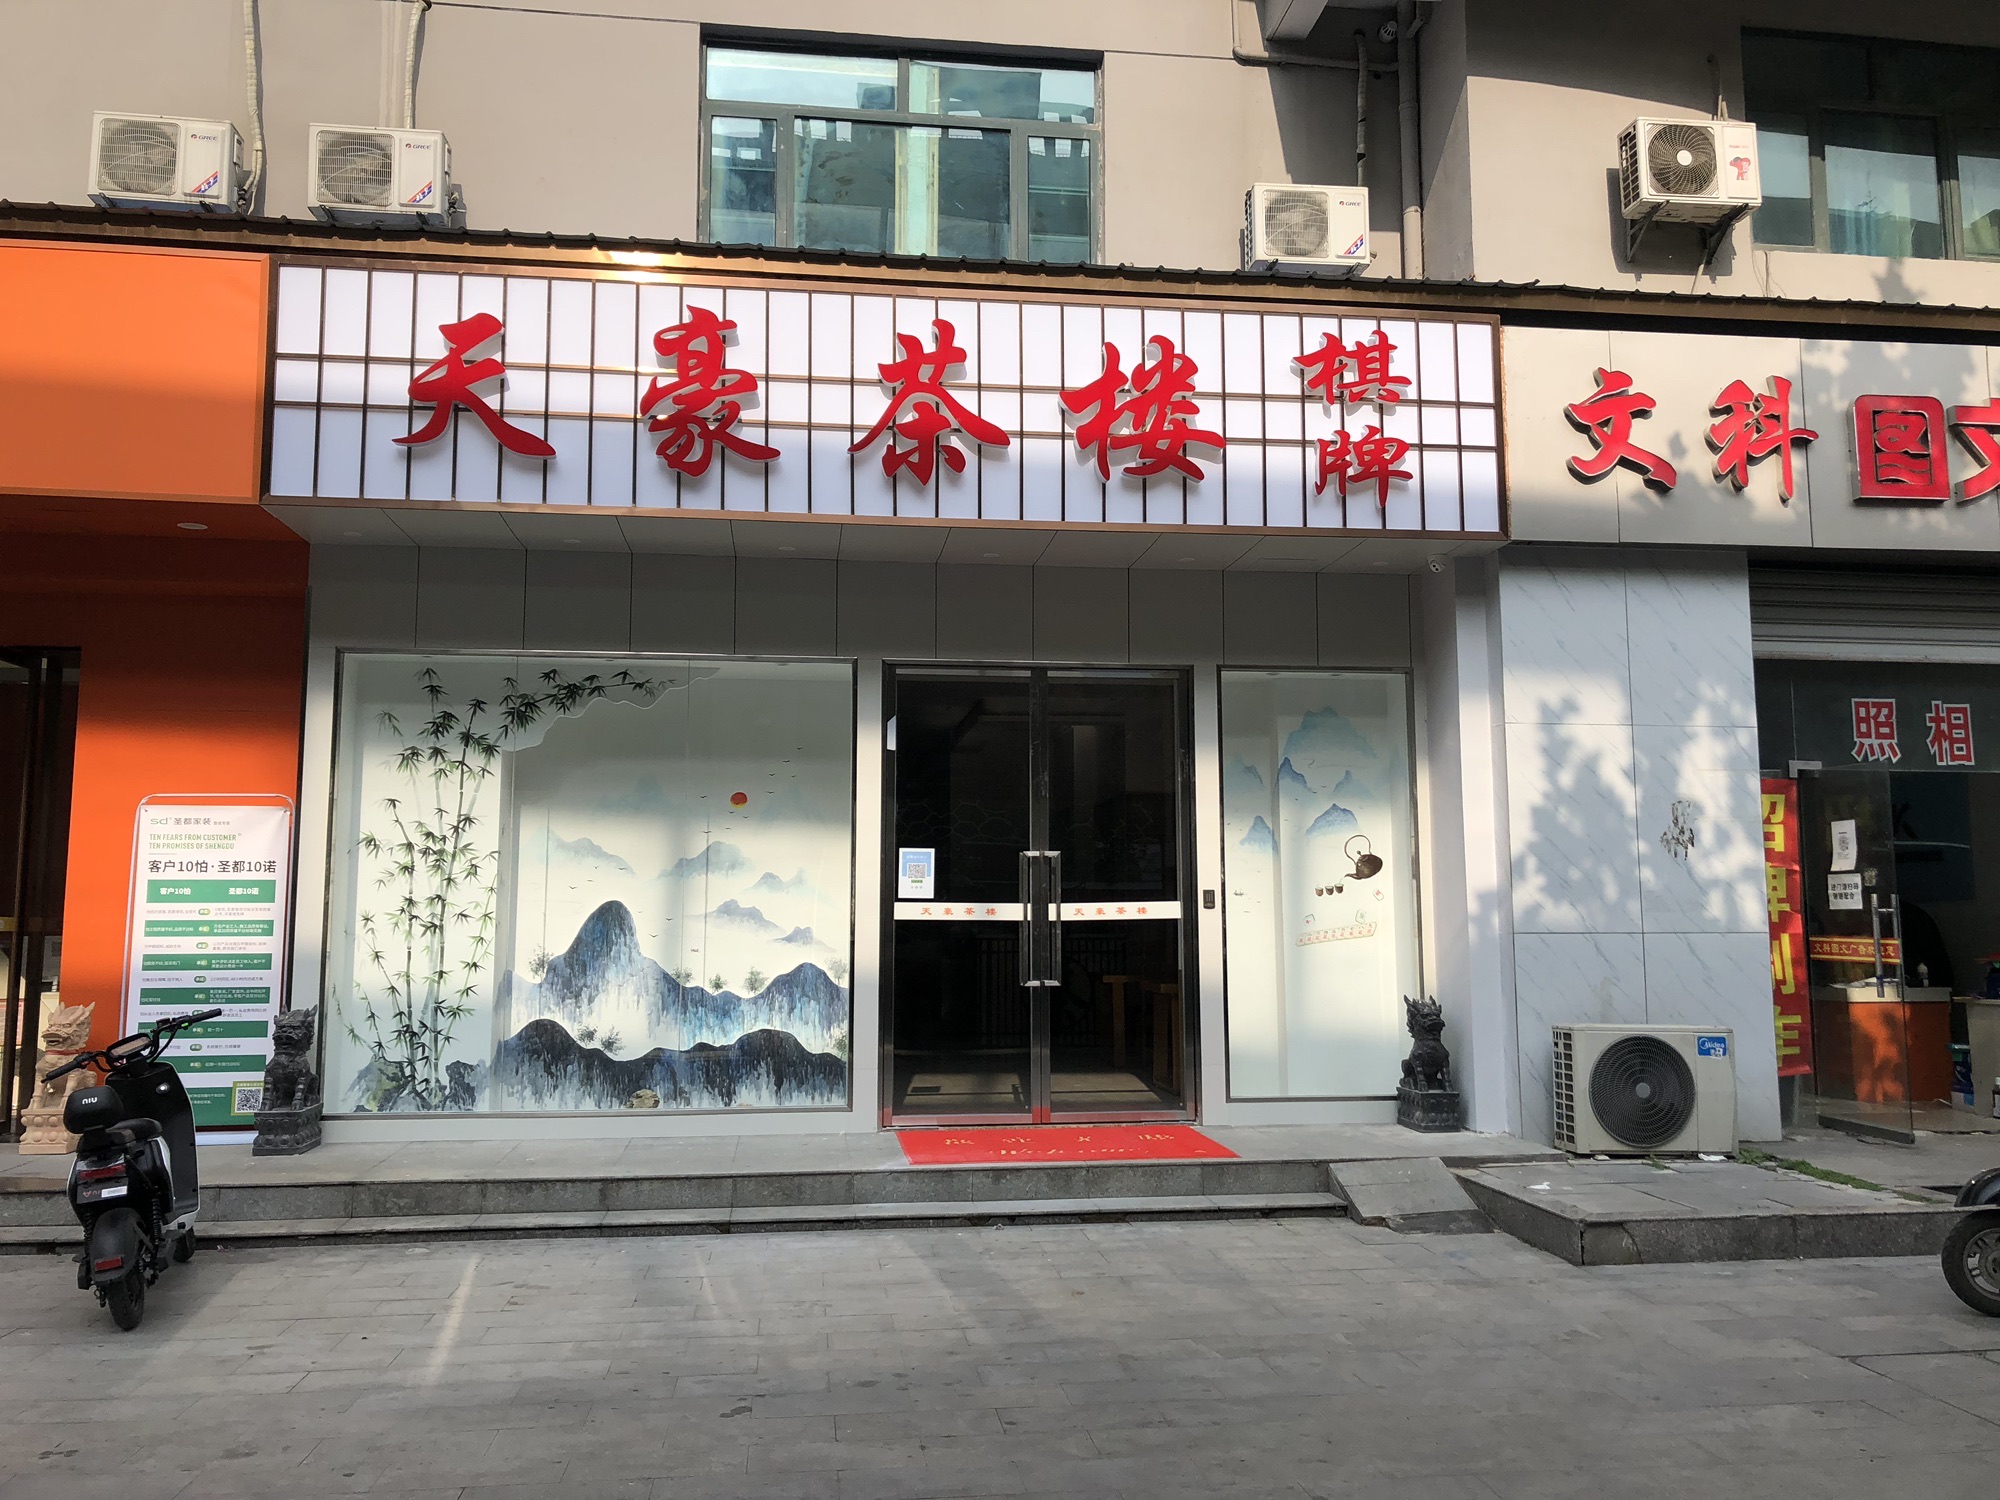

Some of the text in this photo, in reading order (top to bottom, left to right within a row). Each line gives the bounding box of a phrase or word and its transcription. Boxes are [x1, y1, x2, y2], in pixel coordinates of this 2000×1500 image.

[391, 304, 1227, 487] 天豪茶楼
[1292, 330, 1414, 509] 棋牌
[1851, 698, 1975, 765] 照相
[149, 833, 237, 841] TEN FEARS FROM CUSTOMER
[148, 842, 235, 850] TEN PROMISES OF SHENGDU
[159, 887, 192, 895] 客户10怕
[228, 887, 260, 895] 圣都10诺
[1699, 1038, 1725, 1049] Midea
